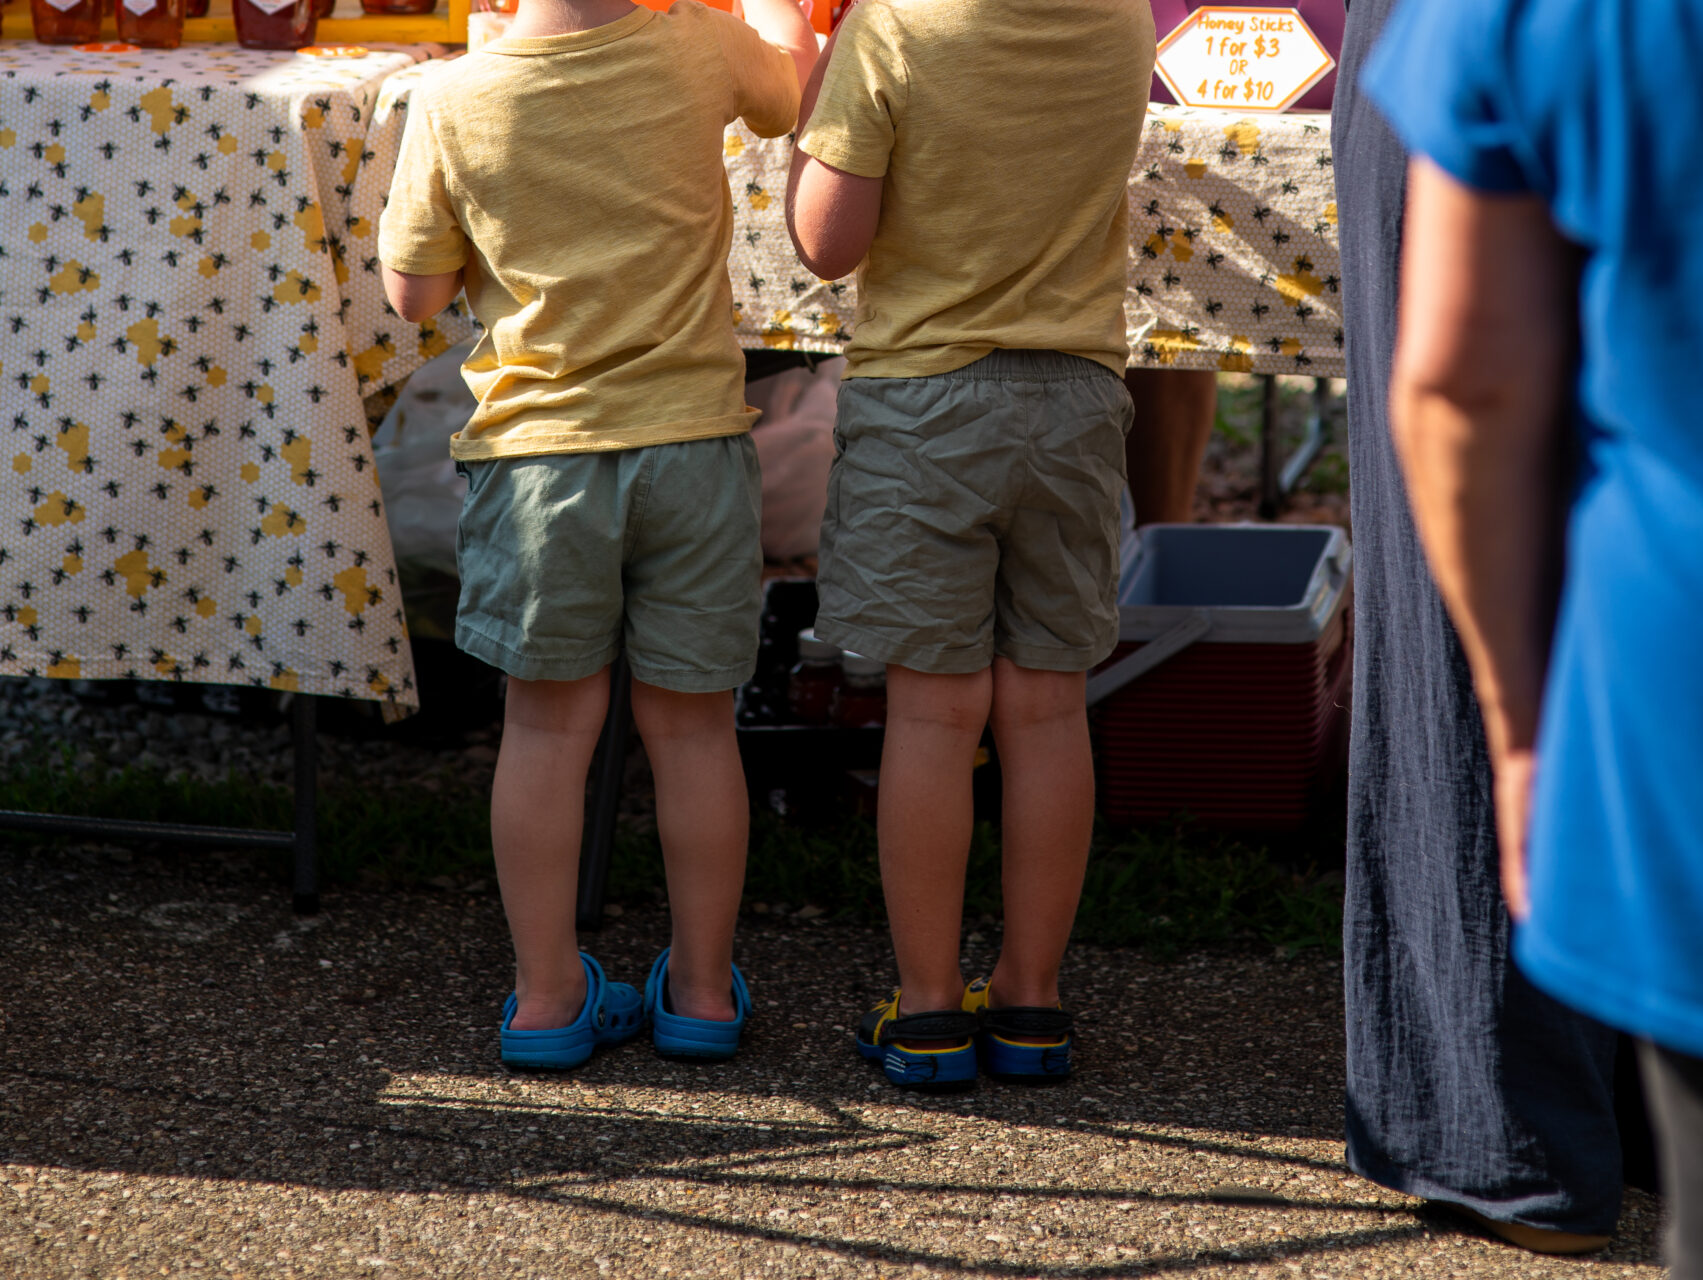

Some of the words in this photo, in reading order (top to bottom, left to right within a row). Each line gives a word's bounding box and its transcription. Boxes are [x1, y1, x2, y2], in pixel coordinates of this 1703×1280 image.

[1197, 15, 1245, 35] Honey
[1249, 16, 1294, 33] Sticks
[1205, 36, 1214, 56] 1
[1220, 36, 1248, 57] for
[1253, 34, 1280, 59] $3
[1229, 59, 1249, 76] OR
[1197, 79, 1208, 99] 4
[1214, 79, 1239, 100] for
[1243, 78, 1274, 102] $10
